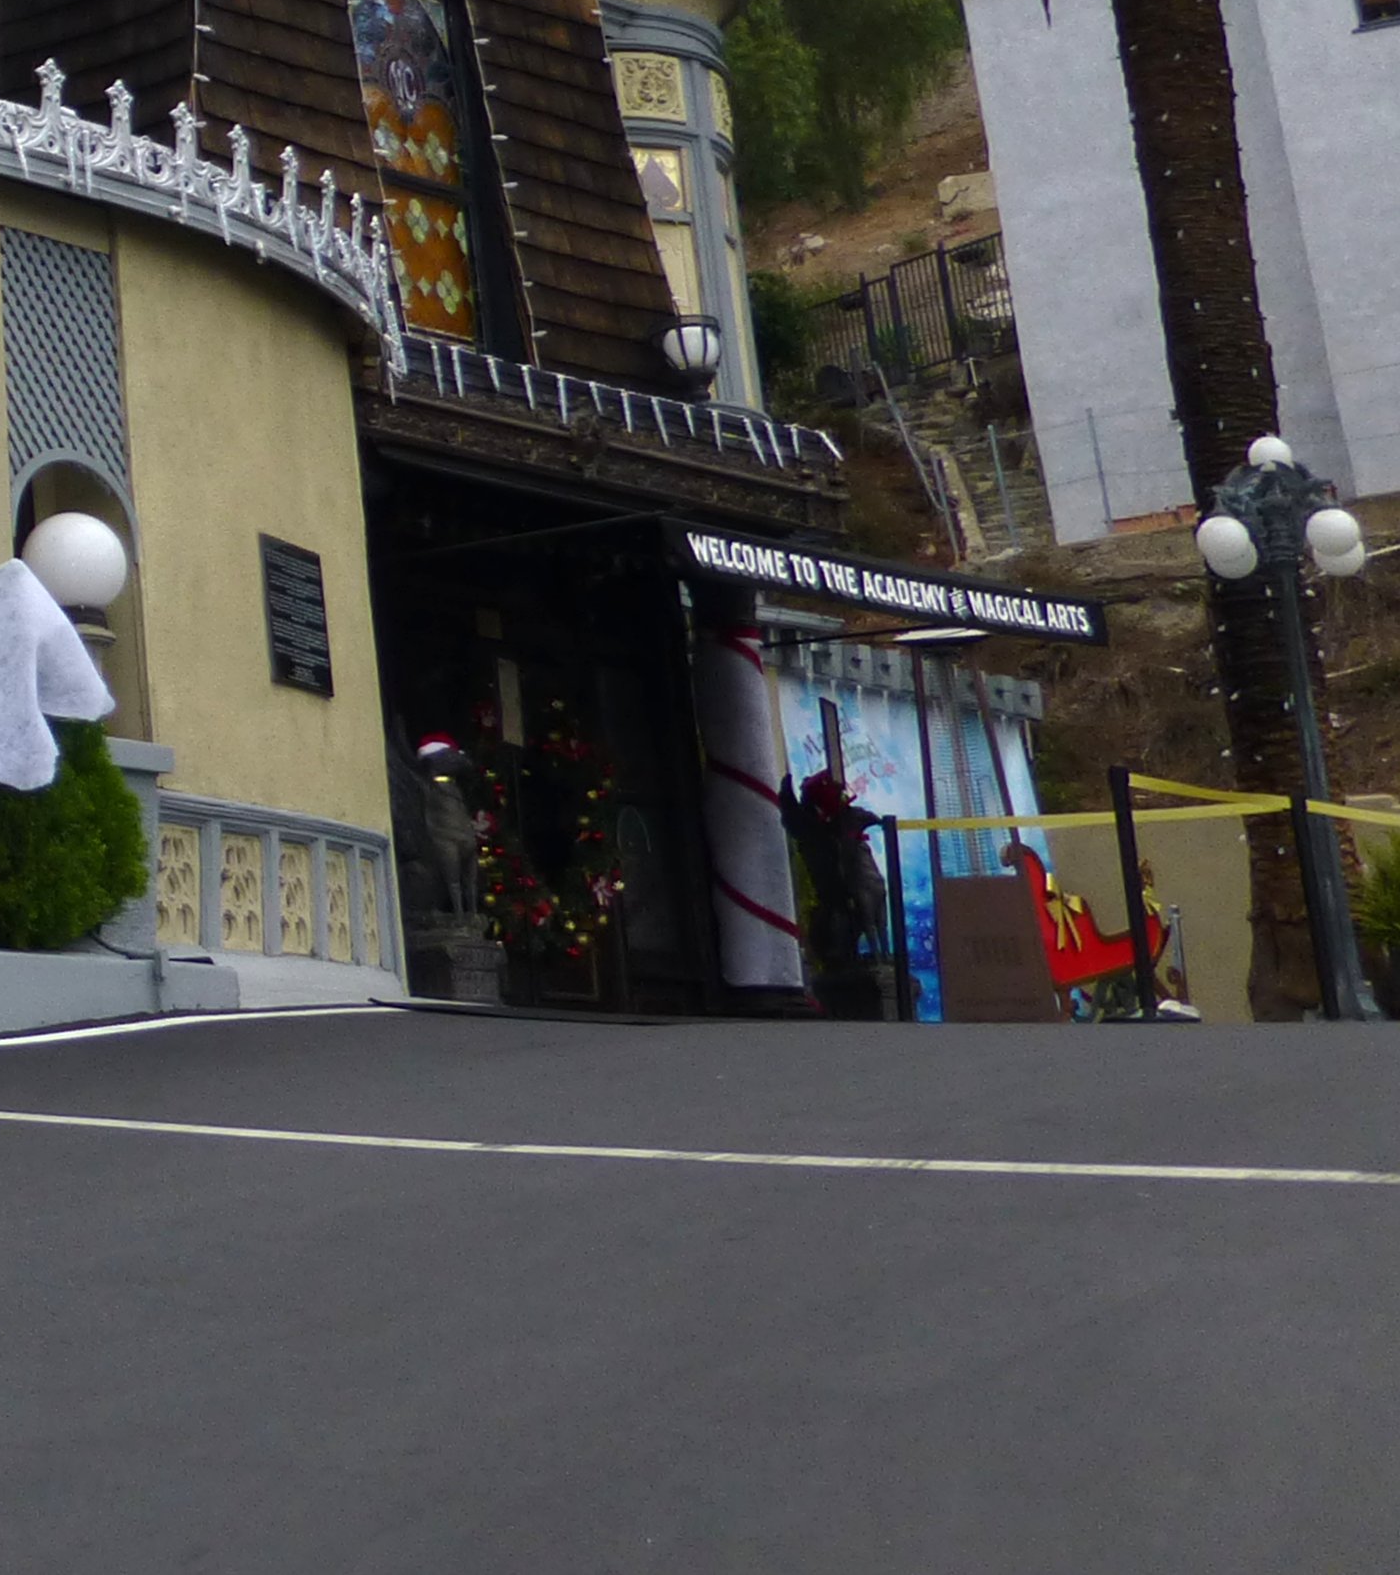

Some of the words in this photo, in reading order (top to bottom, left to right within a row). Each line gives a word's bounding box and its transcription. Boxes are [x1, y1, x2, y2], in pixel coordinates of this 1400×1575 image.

[687, 532, 789, 580] WELCOME
[789, 553, 816, 586] TO
[818, 560, 859, 595] THE
[862, 570, 948, 612] ACADEMY
[967, 590, 1045, 626] MAGICAL
[1046, 603, 1089, 632] ARTS
